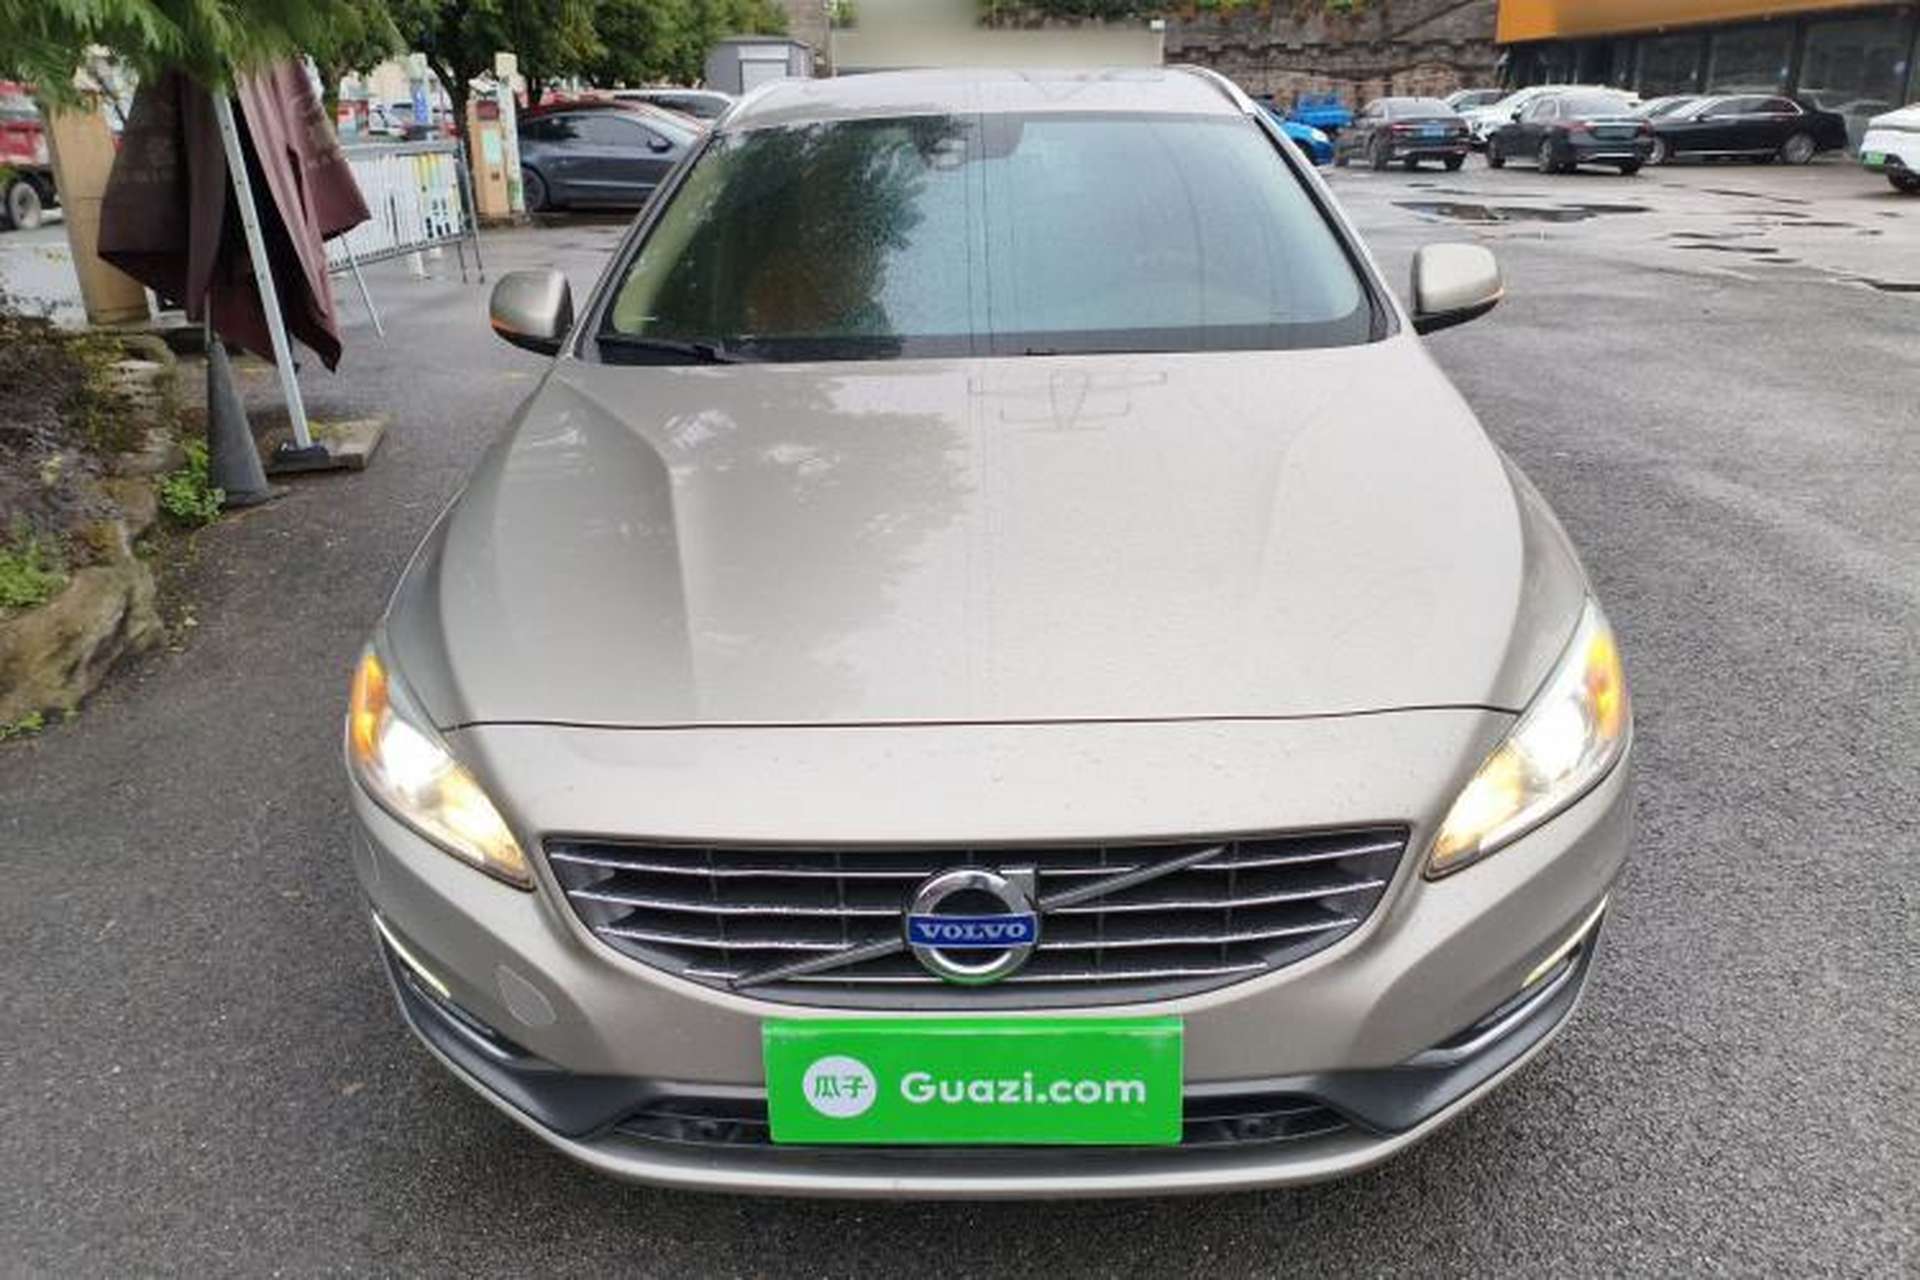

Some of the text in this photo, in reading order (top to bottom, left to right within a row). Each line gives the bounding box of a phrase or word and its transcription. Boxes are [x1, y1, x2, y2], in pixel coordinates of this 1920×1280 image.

[917, 922, 1027, 940] VOLVO
[814, 1073, 869, 1099] 瓜子
[899, 1070, 1147, 1105] Guazi.com
